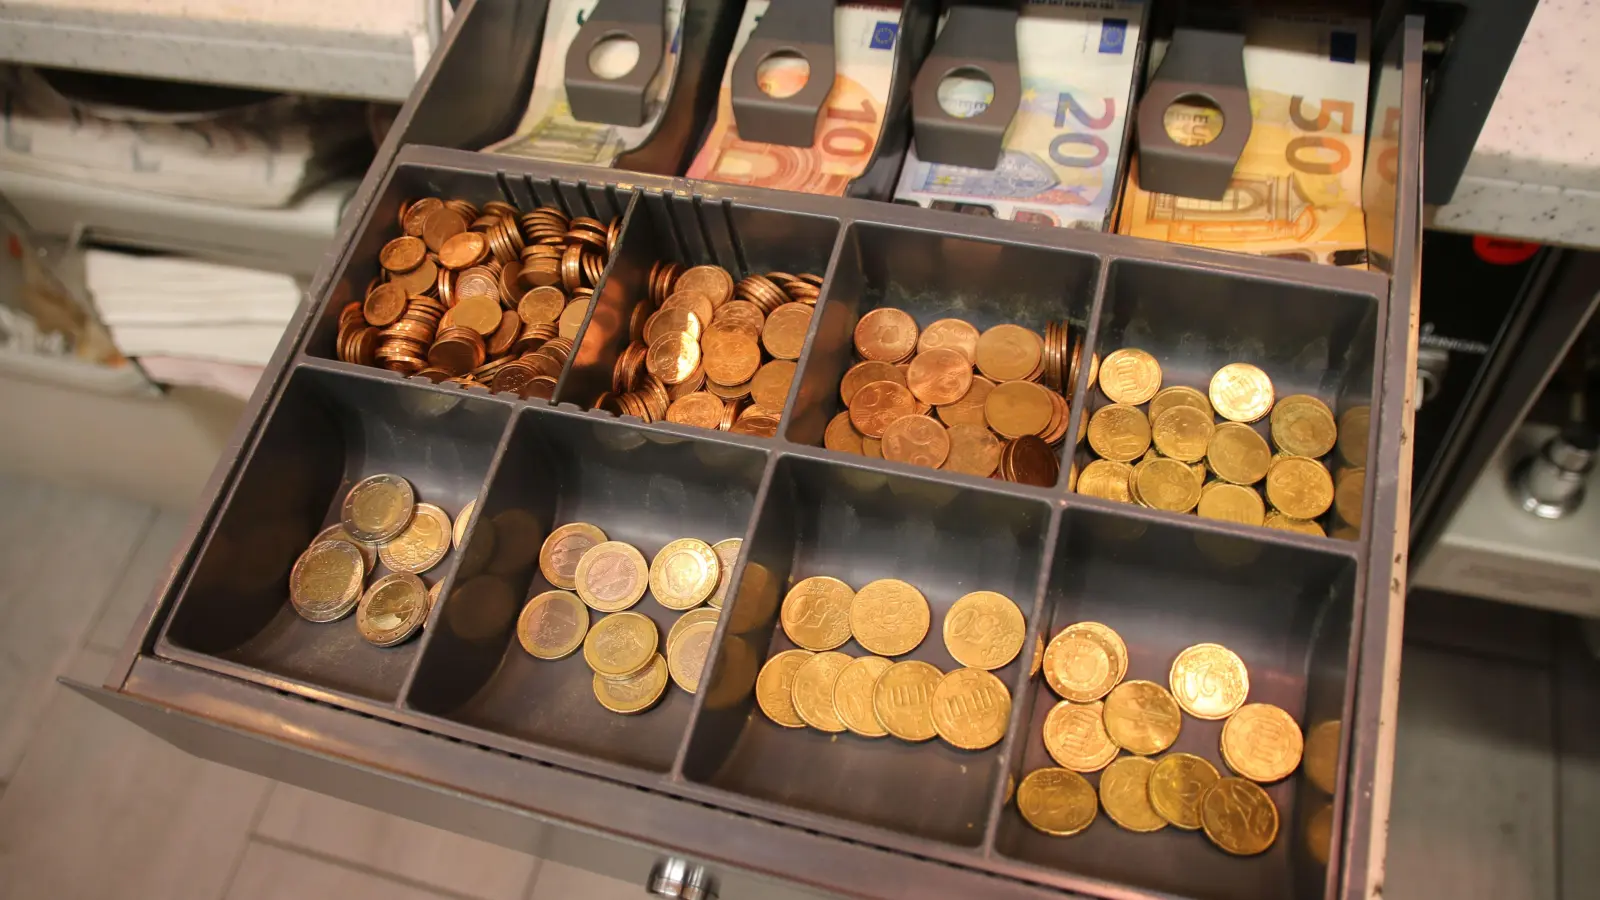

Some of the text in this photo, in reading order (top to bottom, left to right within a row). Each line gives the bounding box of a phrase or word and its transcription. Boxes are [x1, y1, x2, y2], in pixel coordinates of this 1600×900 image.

[820, 98, 877, 157] 10
[1047, 91, 1116, 169] 20
[1285, 95, 1355, 175] 50
